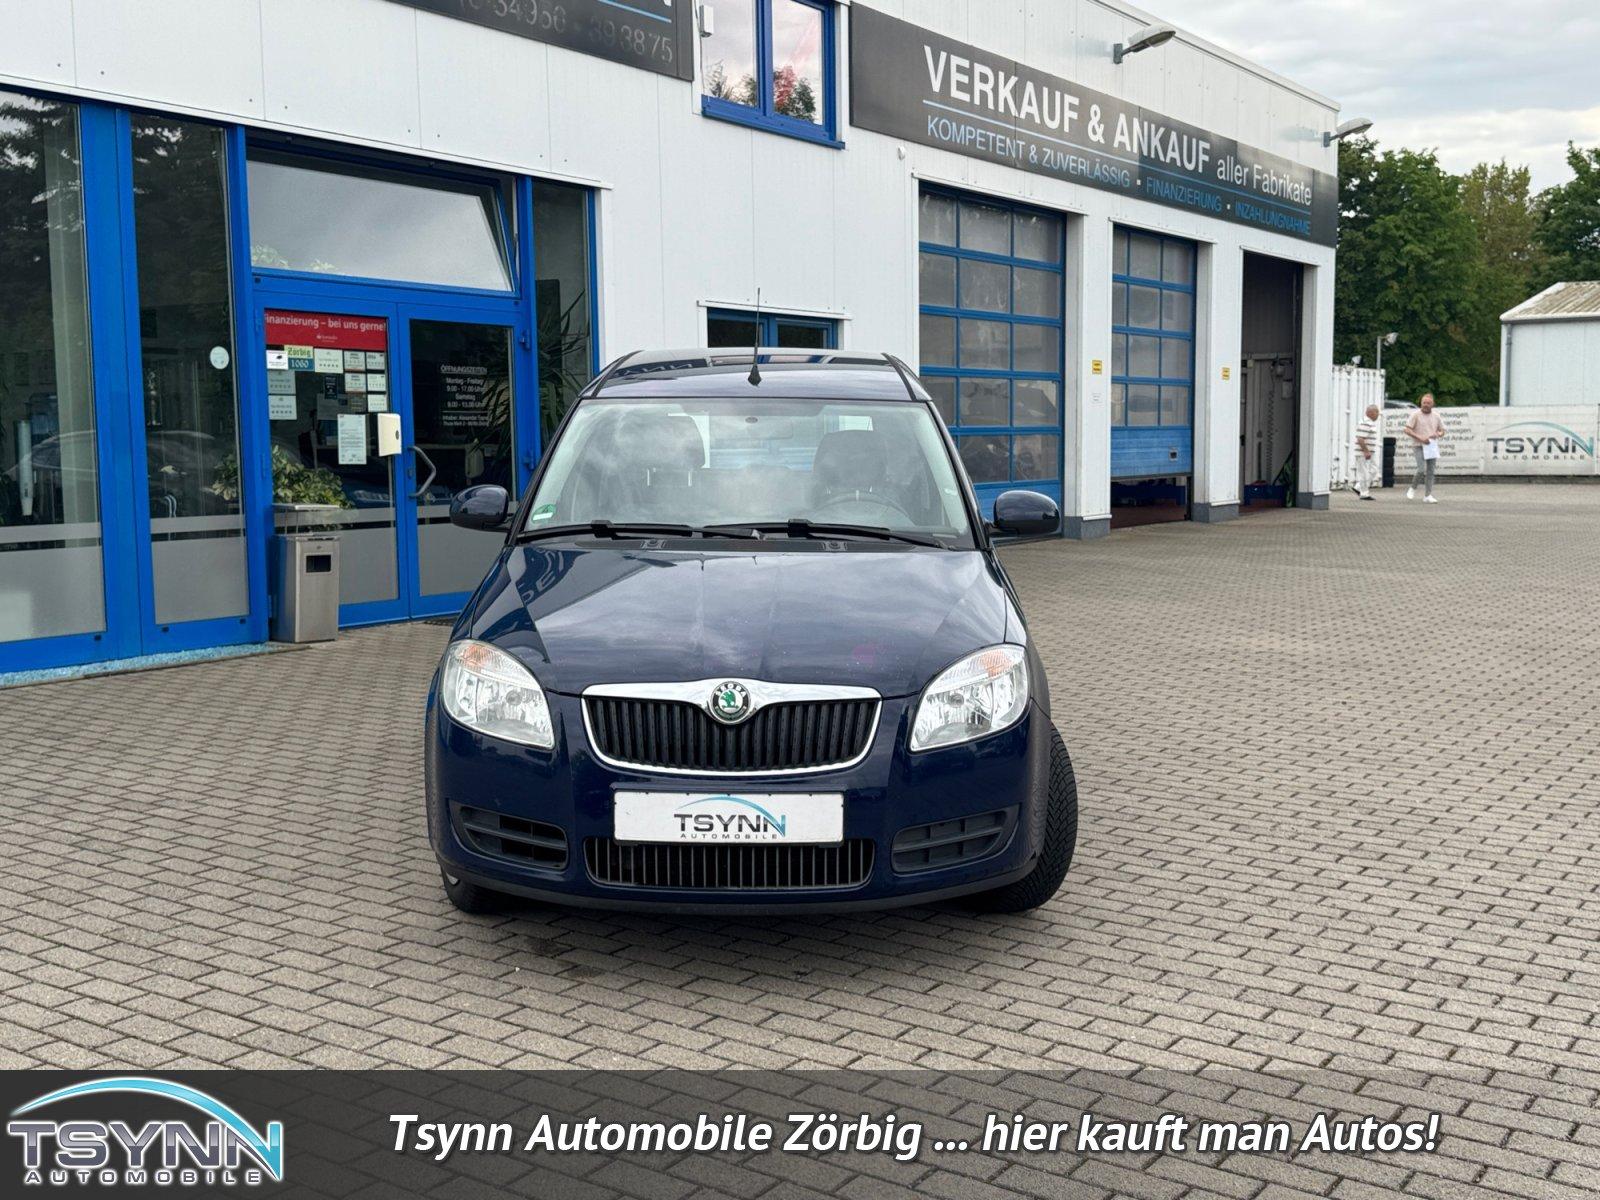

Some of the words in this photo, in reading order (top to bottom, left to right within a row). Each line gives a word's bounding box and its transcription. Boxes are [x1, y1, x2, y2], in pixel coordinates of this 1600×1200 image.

[924, 44, 1080, 133] VERKAUF
[1087, 103, 1105, 144] &
[1113, 113, 1210, 173] ANKAUF
[1217, 155, 1249, 187] aller
[1253, 164, 1312, 206] Fabrikate
[927, 114, 1026, 159] KOMPETENT
[1028, 144, 1038, 164] &
[1042, 147, 1130, 188] ZUVERLÄSSIG
[1146, 176, 1222, 212] FINANZIERUNG
[1235, 203, 1311, 236] INZAHLUNGNAHME
[328, 318, 341, 328] bei
[343, 320, 358, 329] uns
[1487, 437, 1594, 456] TSYNN
[674, 813, 786, 837] TSYNN
